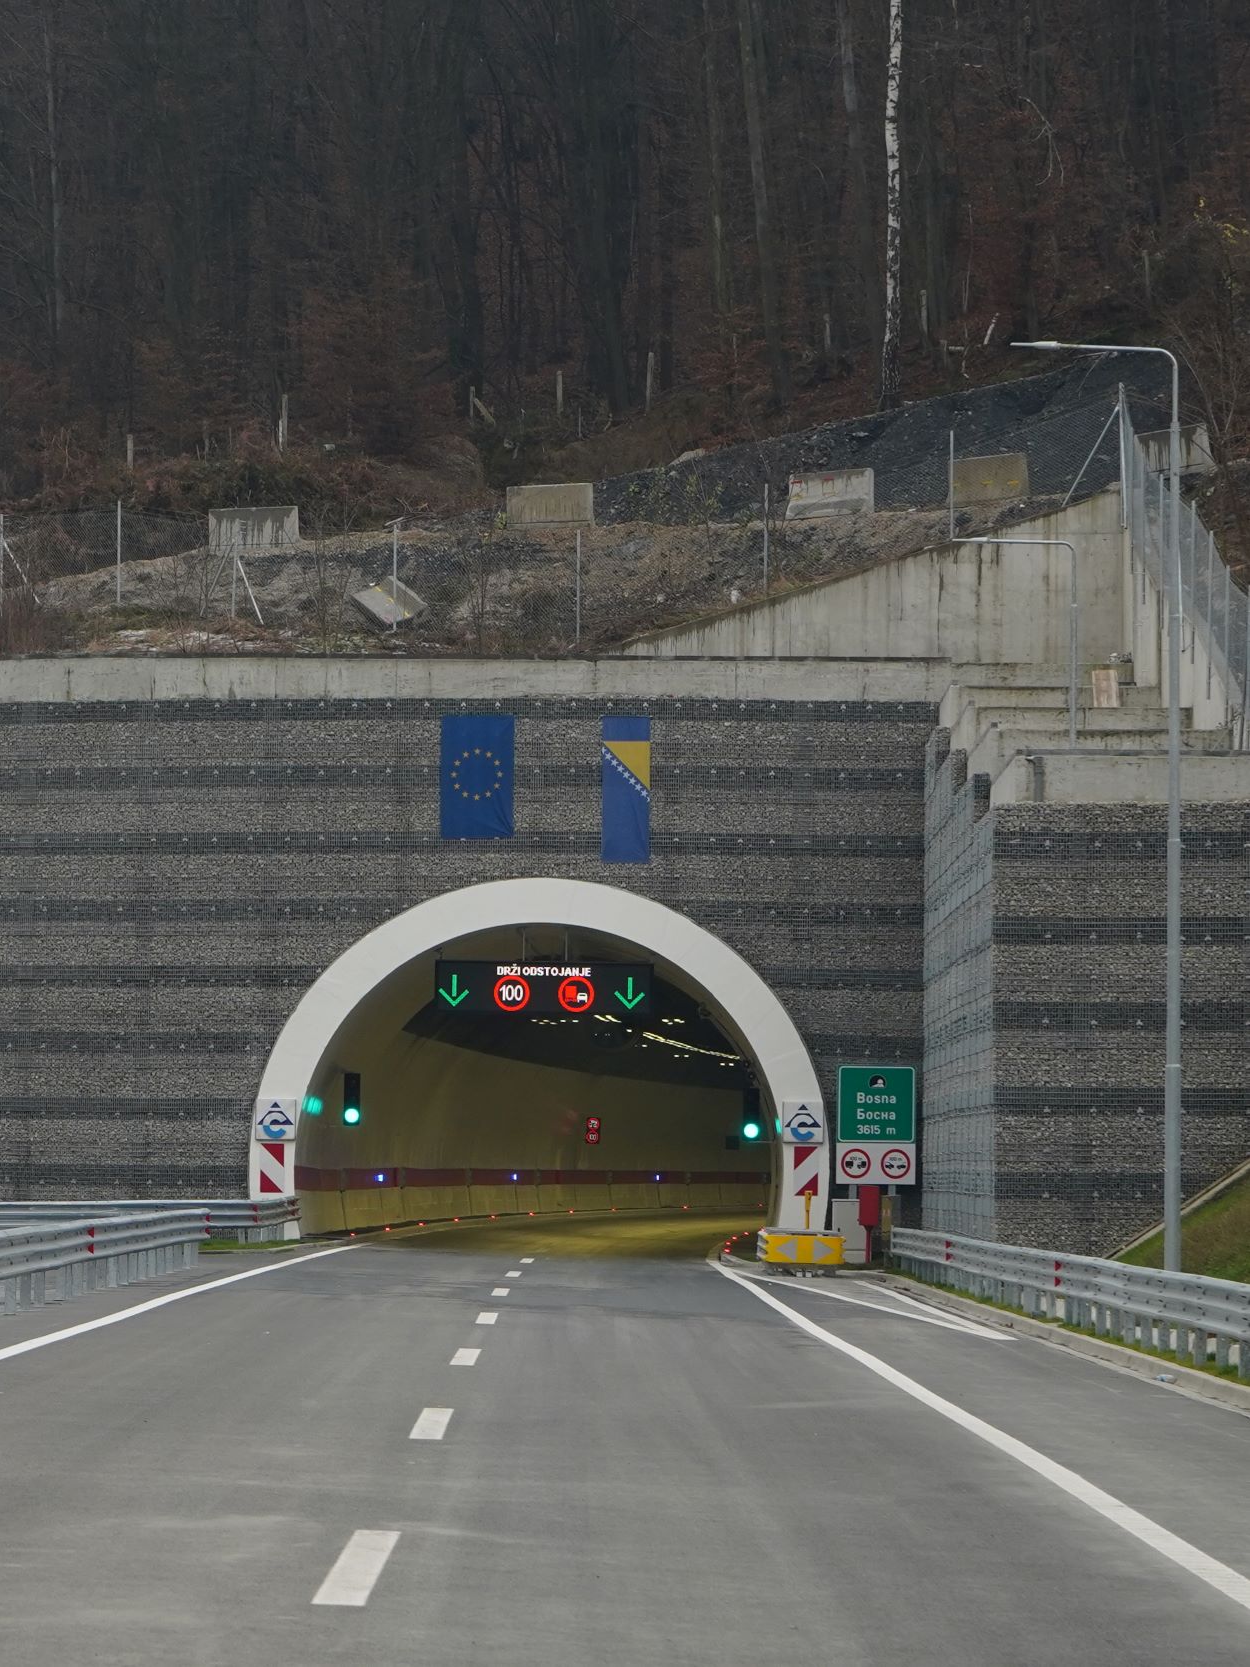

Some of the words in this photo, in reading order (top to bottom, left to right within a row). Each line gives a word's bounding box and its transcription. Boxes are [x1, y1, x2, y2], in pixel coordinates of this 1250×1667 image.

[496, 963, 521, 976] DRŽI
[522, 966, 592, 977] ODSTOJANJE
[499, 984, 524, 1001] 100
[856, 1091, 897, 1104] Bosna
[856, 1108, 896, 1120] Босна
[856, 1124, 881, 1135] 3615
[886, 1127, 896, 1135] m
